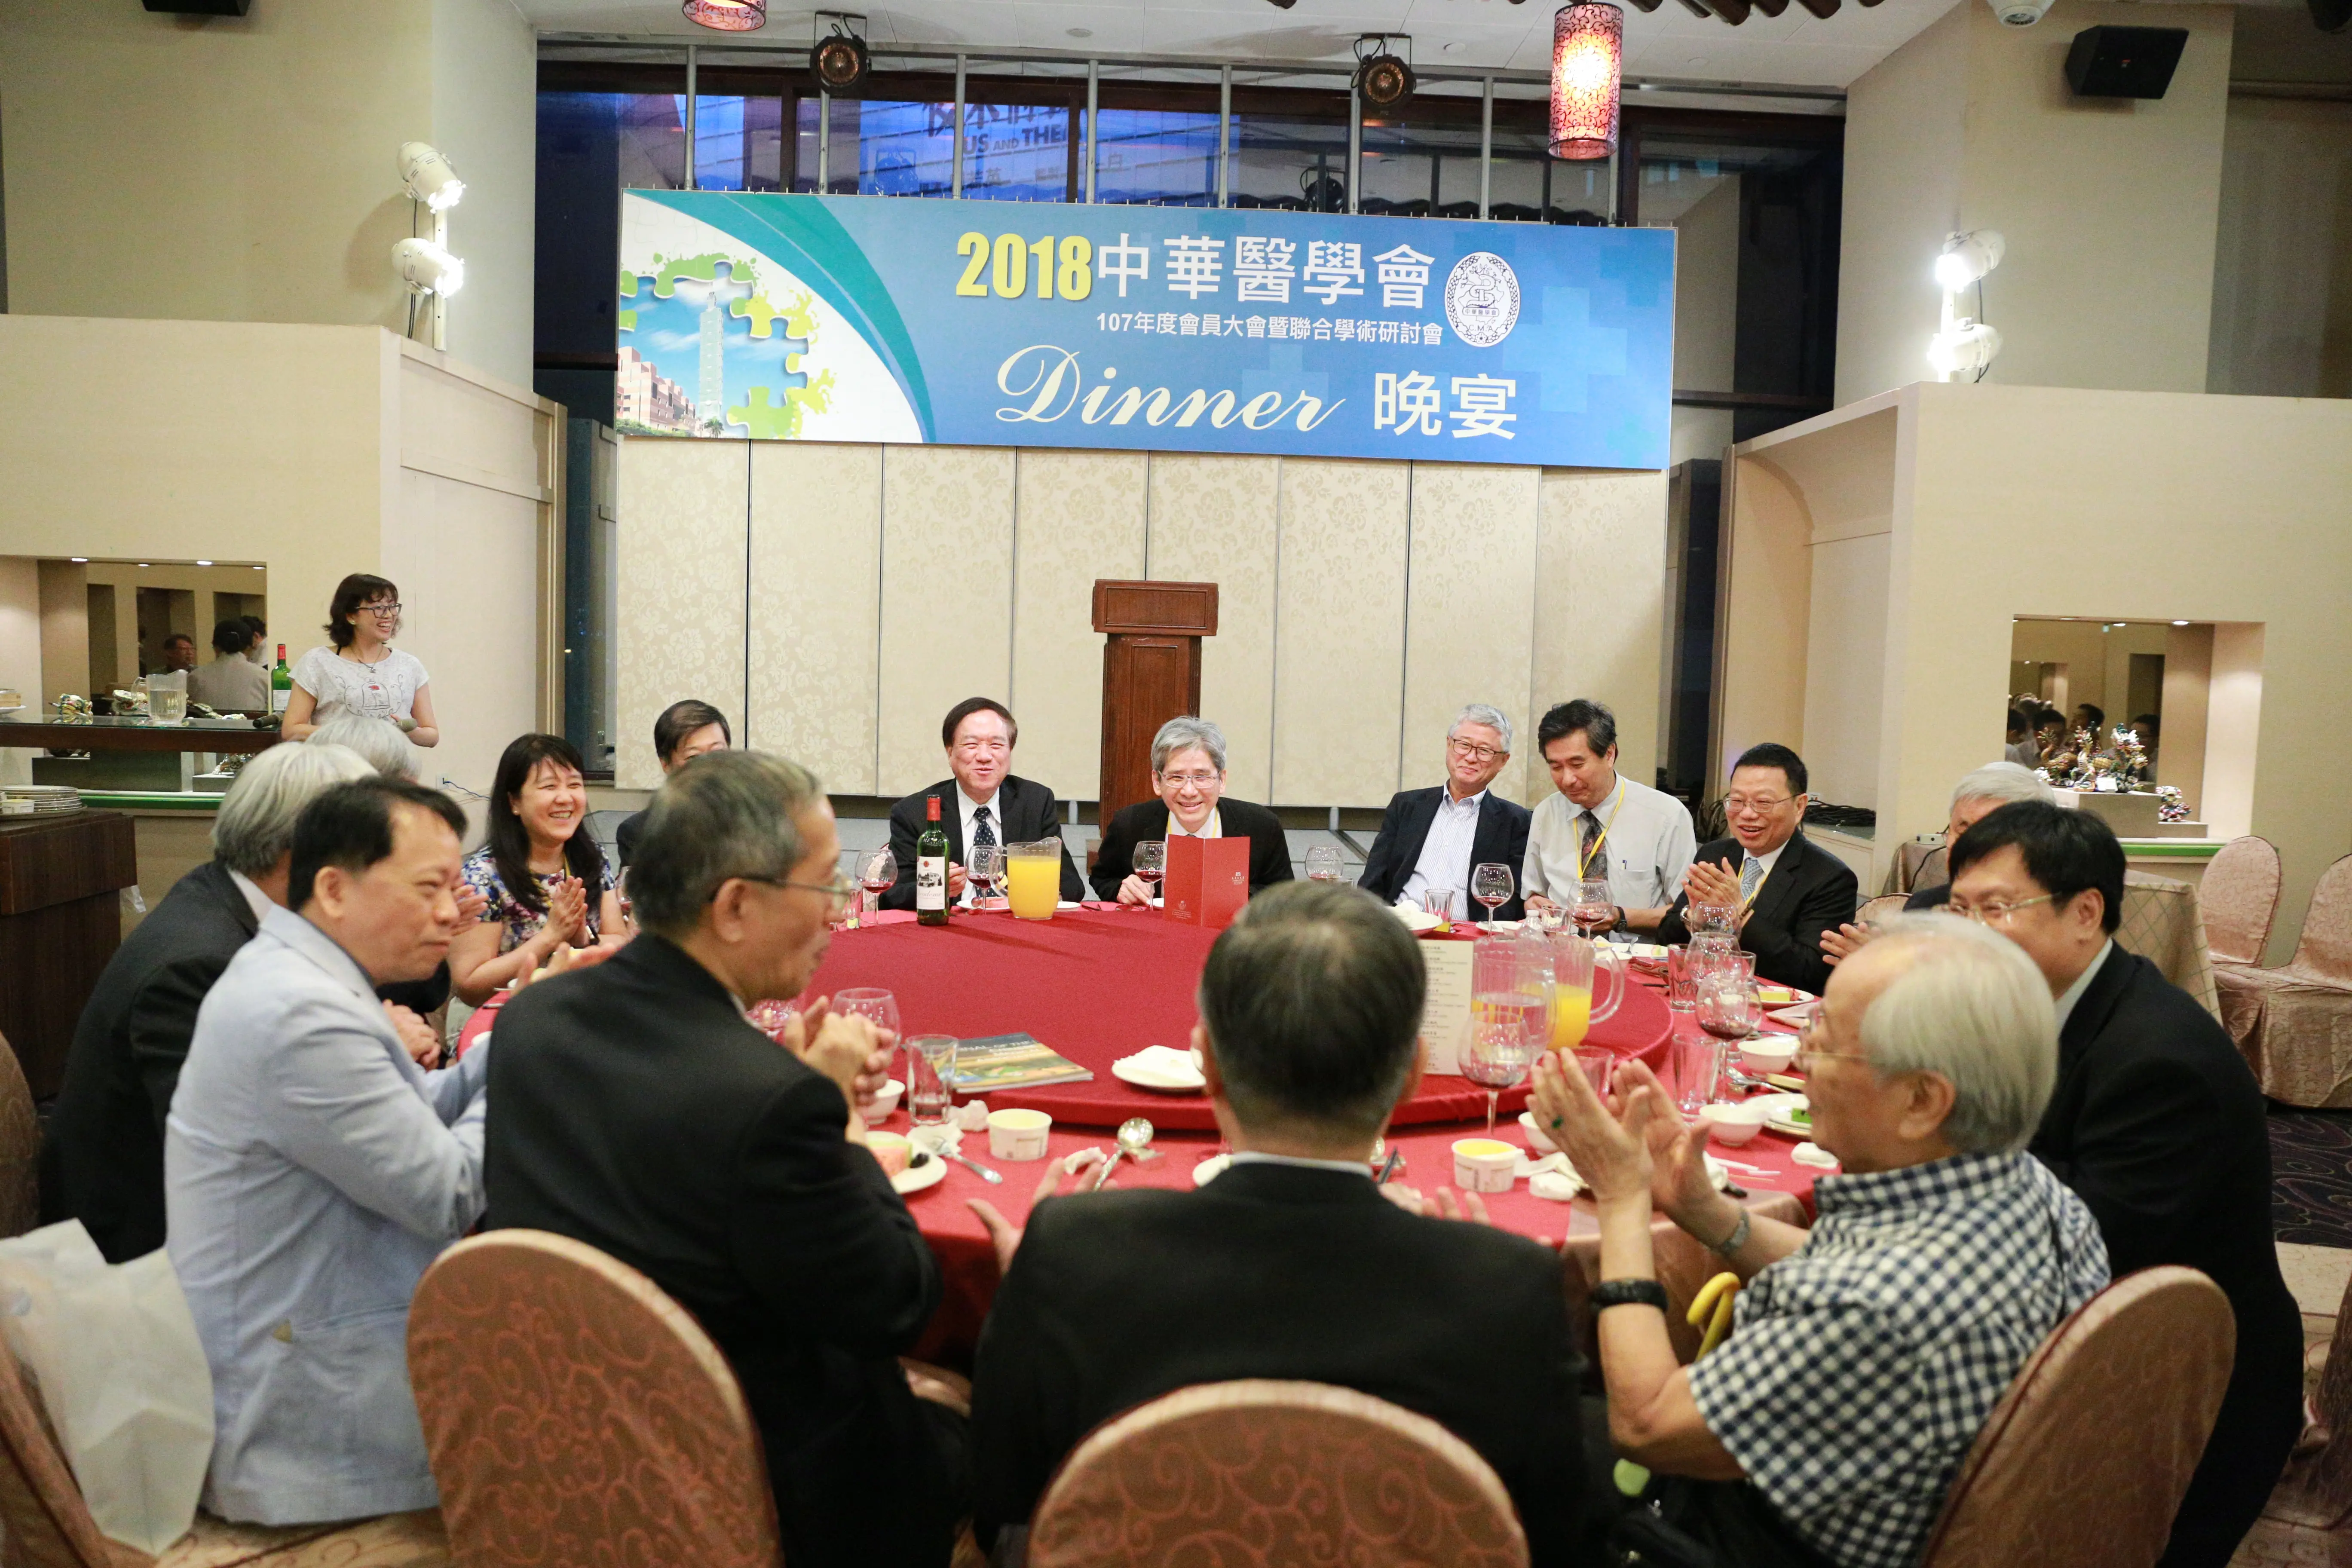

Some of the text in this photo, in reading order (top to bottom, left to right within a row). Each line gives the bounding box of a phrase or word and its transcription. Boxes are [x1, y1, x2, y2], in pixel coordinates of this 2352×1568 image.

[993, 137, 1019, 151] AND
[956, 232, 1436, 309] 2018 中華醫學會
[1096, 311, 1443, 346] 107年度會員大會暨聯合學術研討會
[995, 345, 1518, 440] Dinner 晚宴
